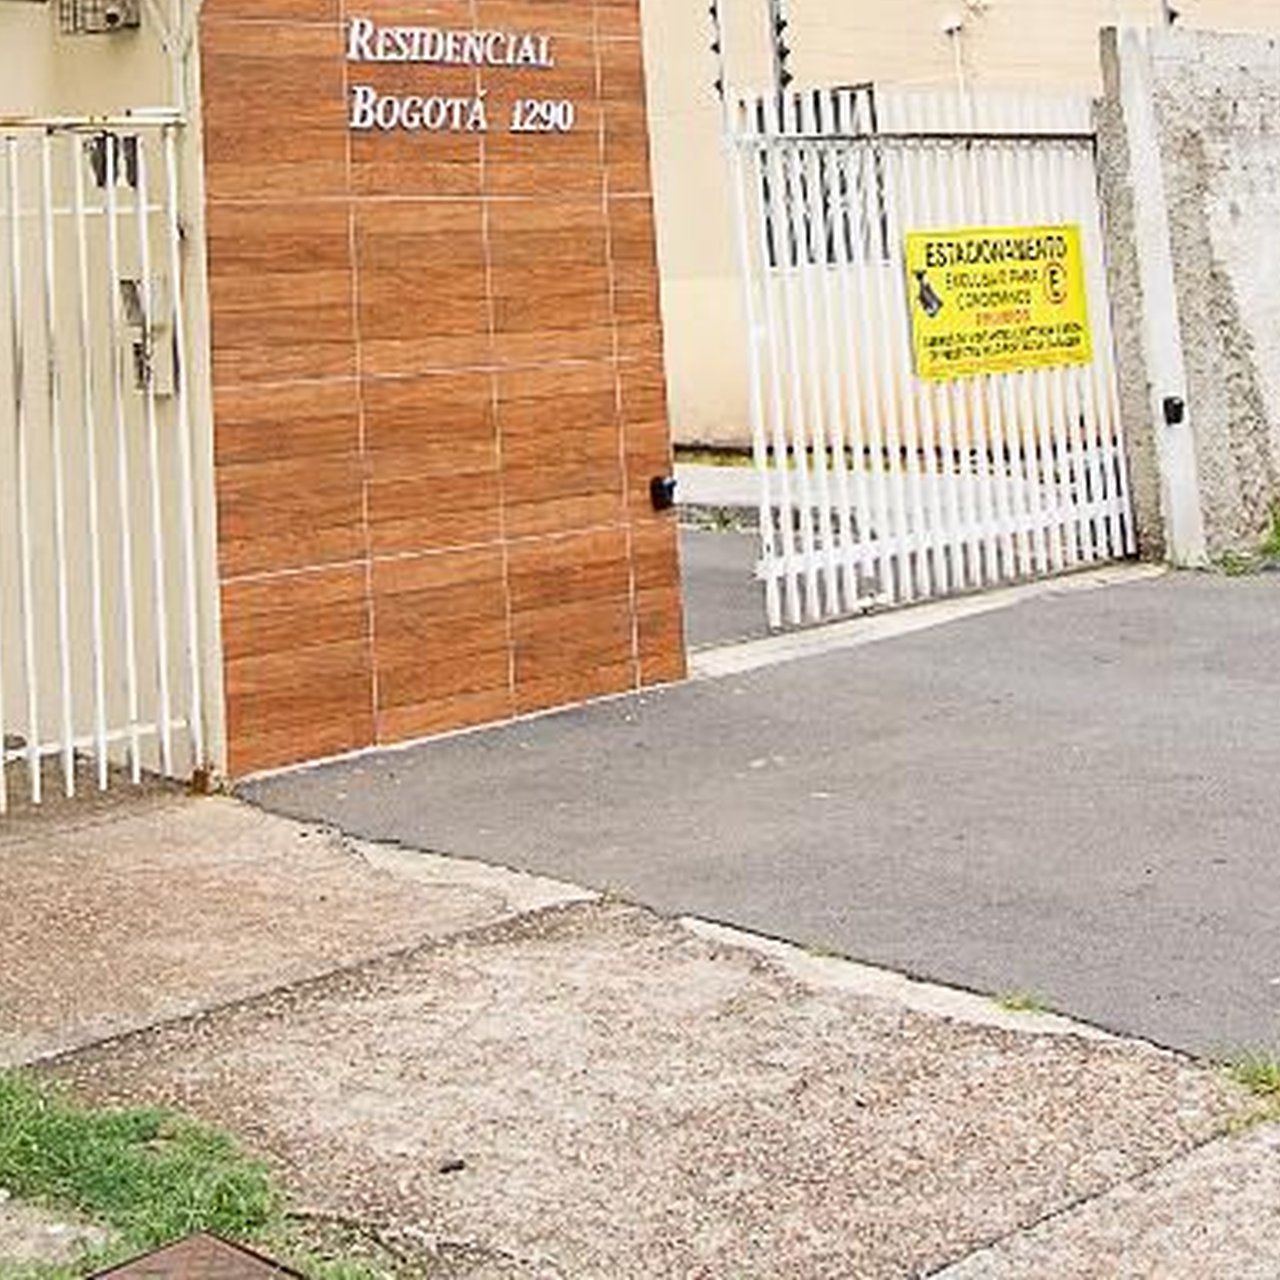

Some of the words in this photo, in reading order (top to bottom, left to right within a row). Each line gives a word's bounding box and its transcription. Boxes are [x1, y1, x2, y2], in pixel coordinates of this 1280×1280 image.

[347, 18, 554, 67] RESIDENCIAL
[350, 86, 488, 131] BOGOTÁ
[509, 99, 574, 131] 1290
[925, 235, 1068, 268] ESTACIONAMENTO
